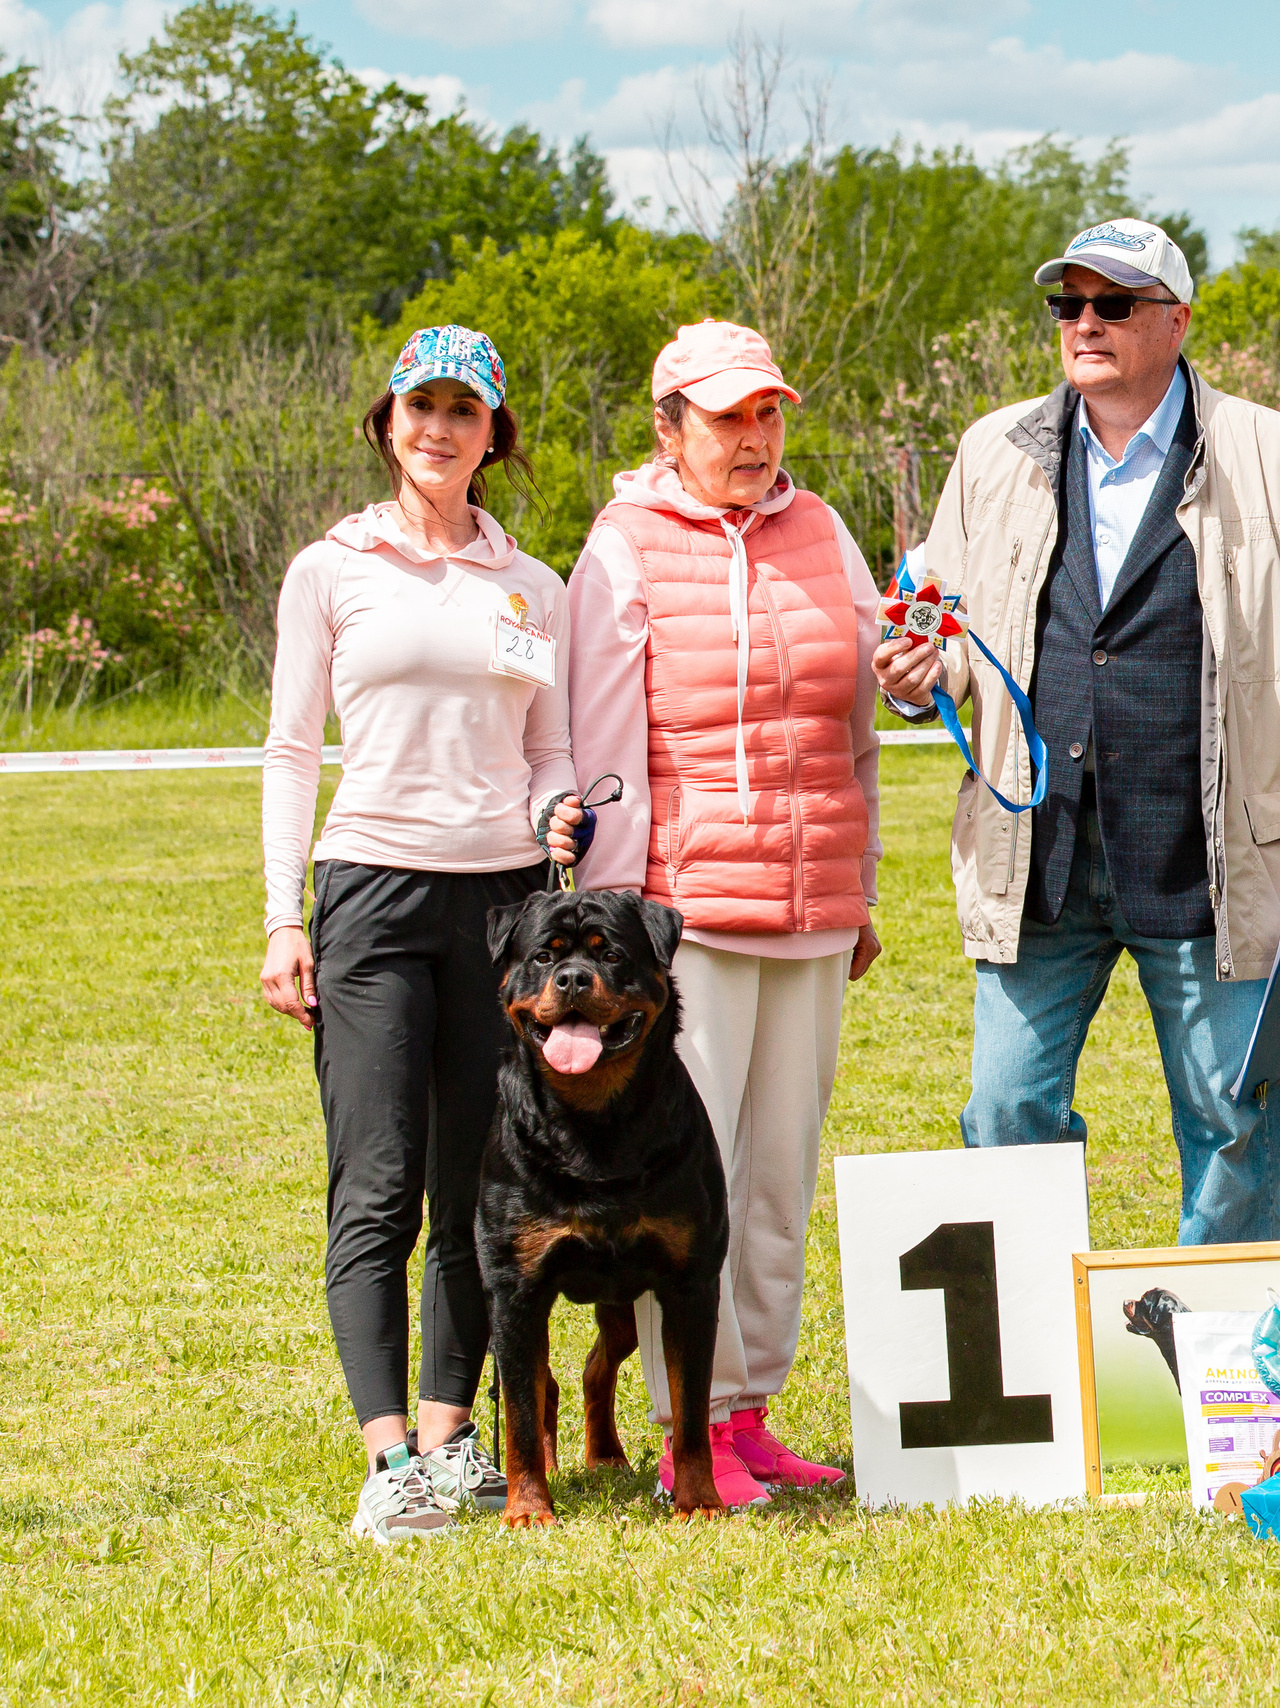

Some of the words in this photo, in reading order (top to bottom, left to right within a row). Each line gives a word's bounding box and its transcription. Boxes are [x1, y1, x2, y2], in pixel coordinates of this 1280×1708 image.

[525, 628, 551, 643] CANIN
[506, 635, 534, 659] 28
[899, 1221, 1054, 1449] 1
[1206, 1367, 1258, 1379] AMINO
[1205, 1392, 1269, 1402] COMPLEX
